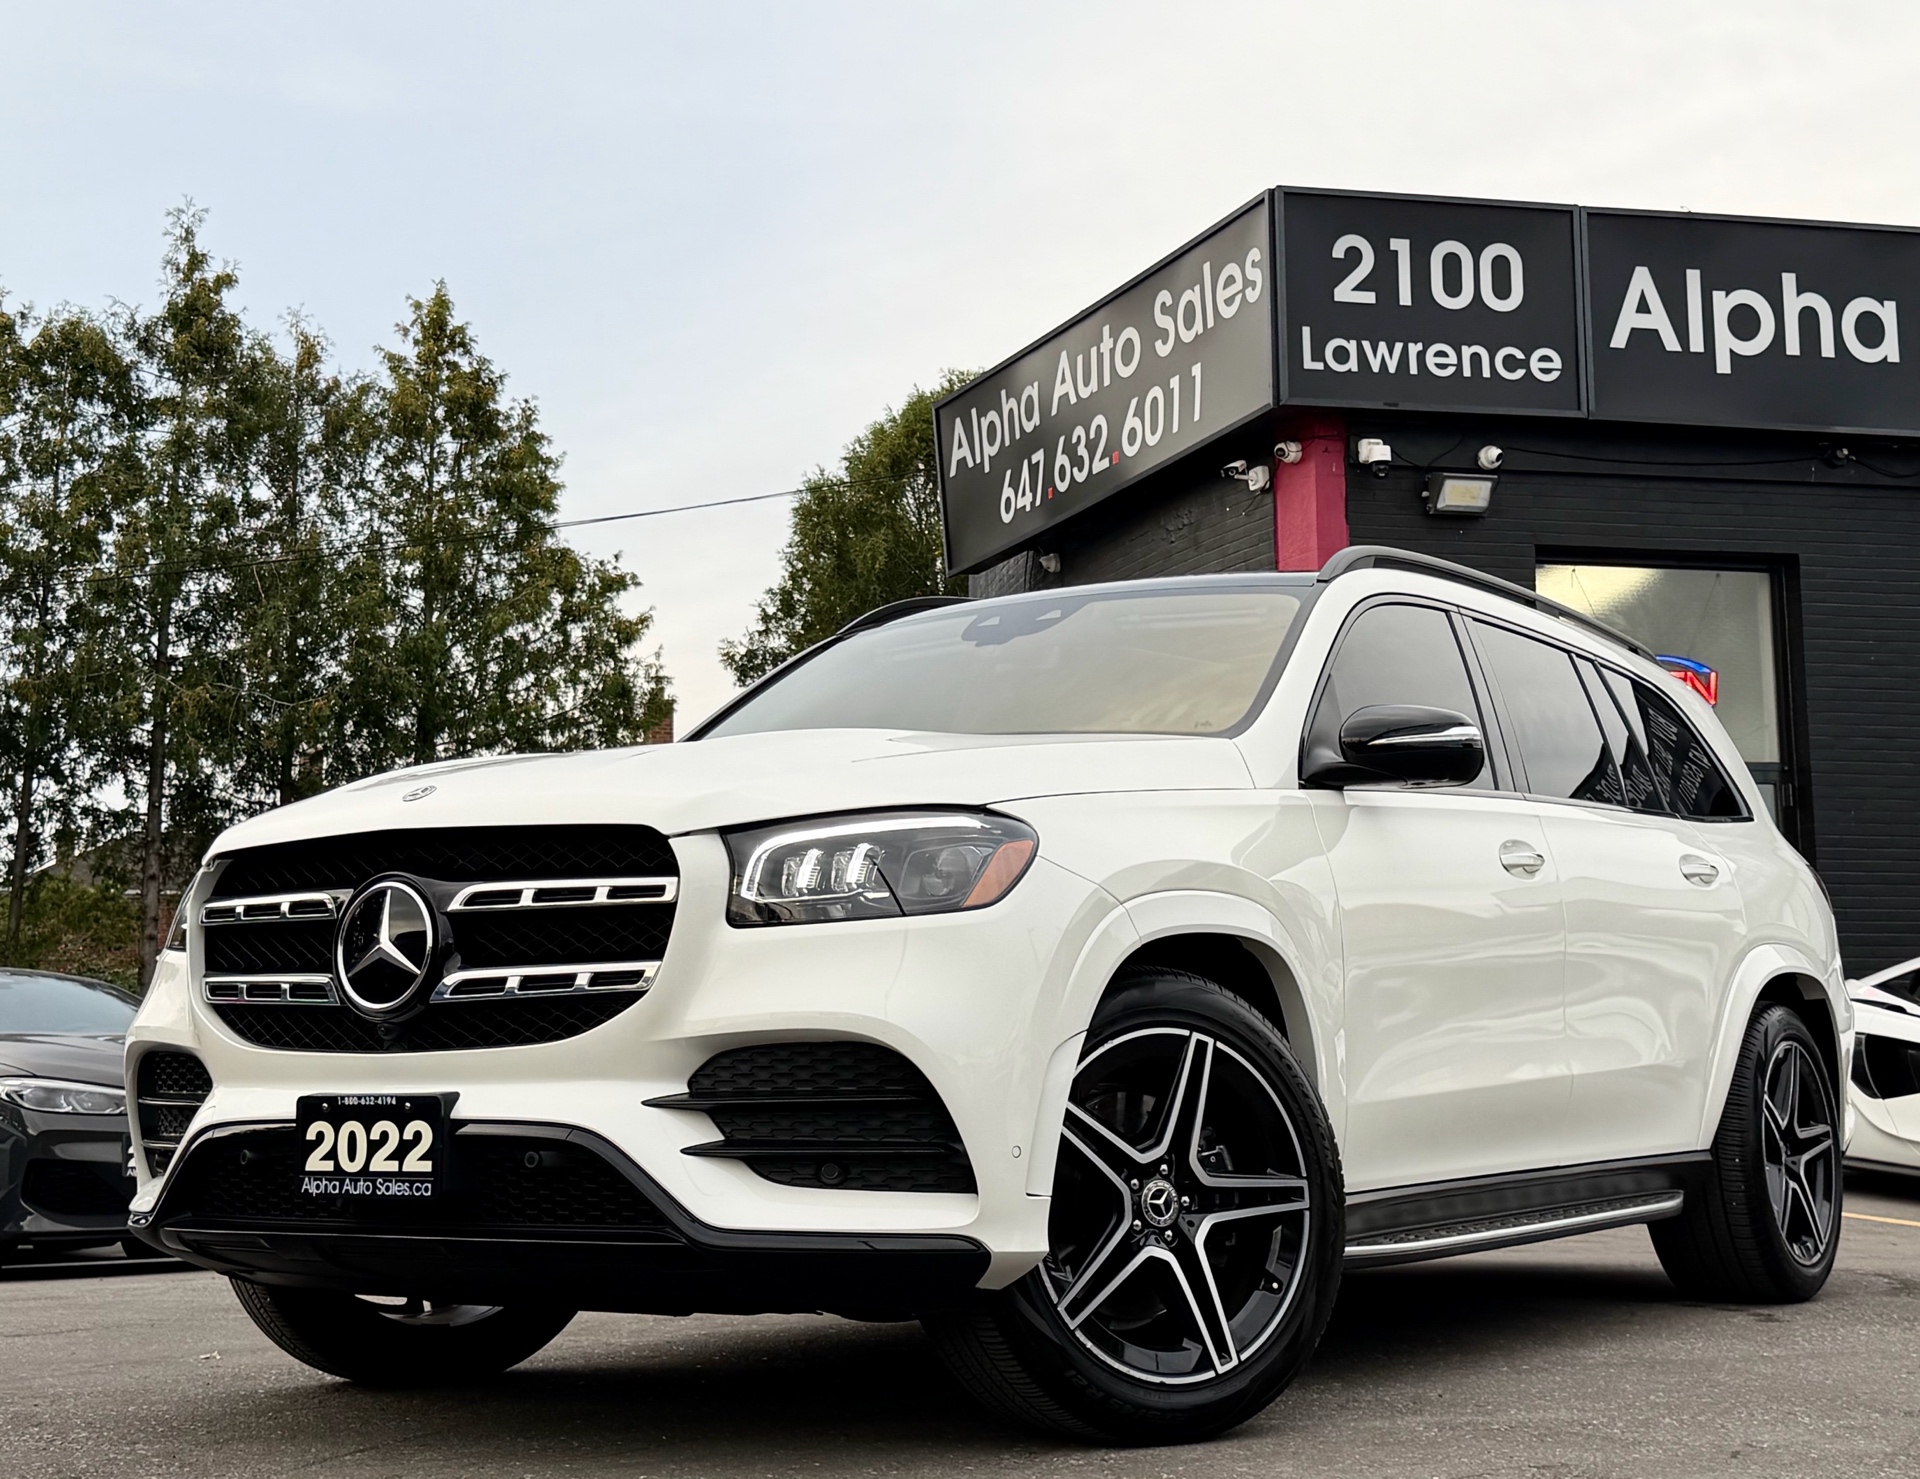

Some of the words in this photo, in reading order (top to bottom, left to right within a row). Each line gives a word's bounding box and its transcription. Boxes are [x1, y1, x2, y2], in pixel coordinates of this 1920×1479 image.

[1331, 234, 1525, 312] 2100
[1301, 325, 1564, 382] Lawrence
[1609, 265, 1901, 374] Alpha
[949, 380, 1041, 478] Alpha
[1051, 324, 1142, 417] Auto
[1154, 247, 1263, 358] Sales
[1000, 362, 1202, 524] 647.632.6011
[304, 1120, 433, 1173] 2022
[301, 1177, 339, 1197] Alpha
[342, 1178, 373, 1195] Auto
[376, 1178, 432, 1196] Sales.ca
